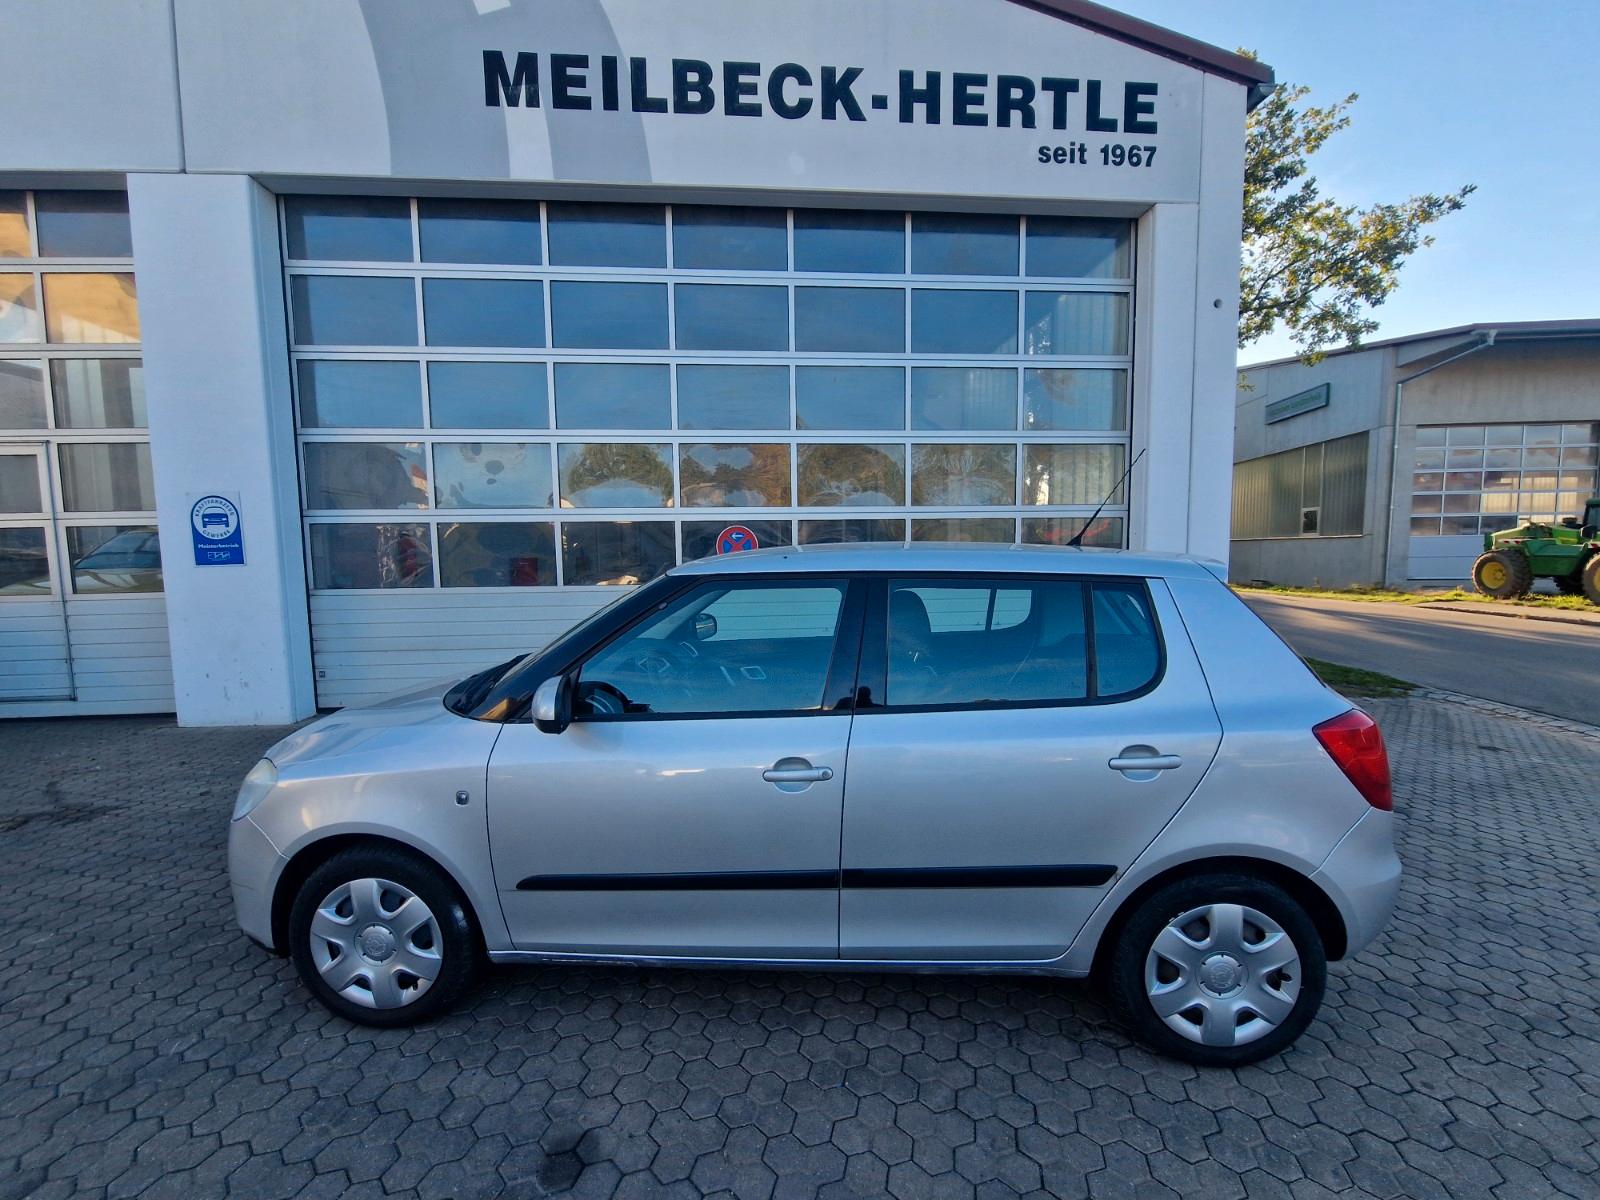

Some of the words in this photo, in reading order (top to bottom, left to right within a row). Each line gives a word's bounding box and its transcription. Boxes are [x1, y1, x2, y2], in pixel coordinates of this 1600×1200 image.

[482, 49, 1158, 135] MEILBECK-HERTLE
[1038, 141, 1087, 165] seit
[1100, 143, 1157, 168] 1967
